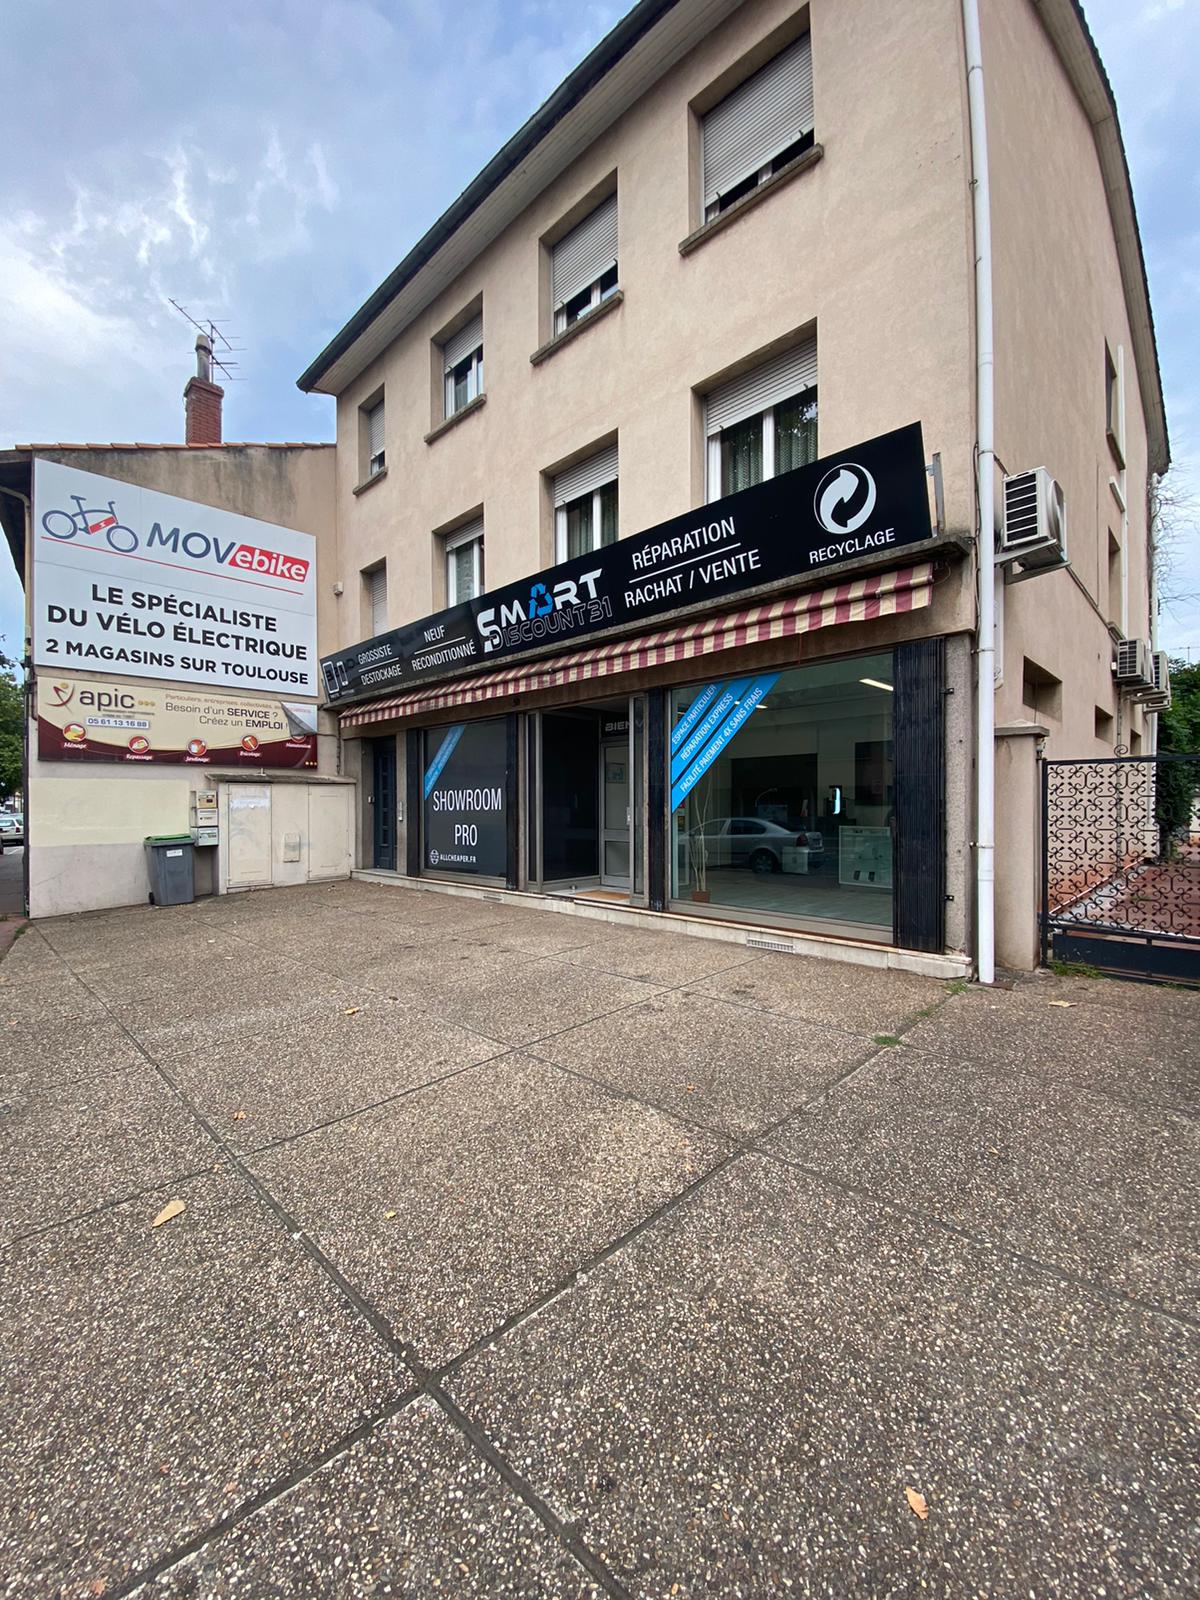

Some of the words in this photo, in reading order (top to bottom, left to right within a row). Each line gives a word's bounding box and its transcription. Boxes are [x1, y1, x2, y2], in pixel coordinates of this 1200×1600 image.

[631, 516, 736, 571] RÉPARATION
[809, 527, 896, 565] RECYCLAGE
[624, 574, 684, 609] RACHAT
[689, 568, 695, 589] /
[698, 549, 762, 585] VENTE
[91, 583, 124, 605] LE
[131, 590, 278, 632] SPÉCIALISTE
[47, 604, 88, 627] DU
[96, 611, 165, 639] VÉLO
[172, 622, 308, 661] ÉLECTRIQUE
[424, 624, 446, 643] NEUF
[45, 638, 60, 654] 2
[66, 641, 175, 668] MAGASINS
[180, 656, 224, 673] SUR
[222, 662, 309, 685] TOULOUSE
[357, 643, 393, 665] GROSSISTE
[411, 639, 477, 672] RECONDITIONNÉ
[361, 663, 403, 686] DESTOCKAGE
[79, 688, 135, 711] apic
[165, 703, 201, 714] Besoin
[204, 705, 225, 715] d'un
[227, 708, 270, 719] SERVICE
[709, 692, 734, 725] EXPRESS
[88, 717, 100, 725] 05
[199, 715, 229, 726] Créez
[245, 720, 284, 730] EMPLOI
[672, 720, 692, 746] ESPACE
[698, 735, 726, 769] PAIEMENT
[723, 723, 734, 738] 4X
[730, 709, 747, 729] SANS
[744, 687, 763, 713] FRAIS
[432, 788, 502, 811] SHOWROOM
[454, 823, 478, 846] PRO
